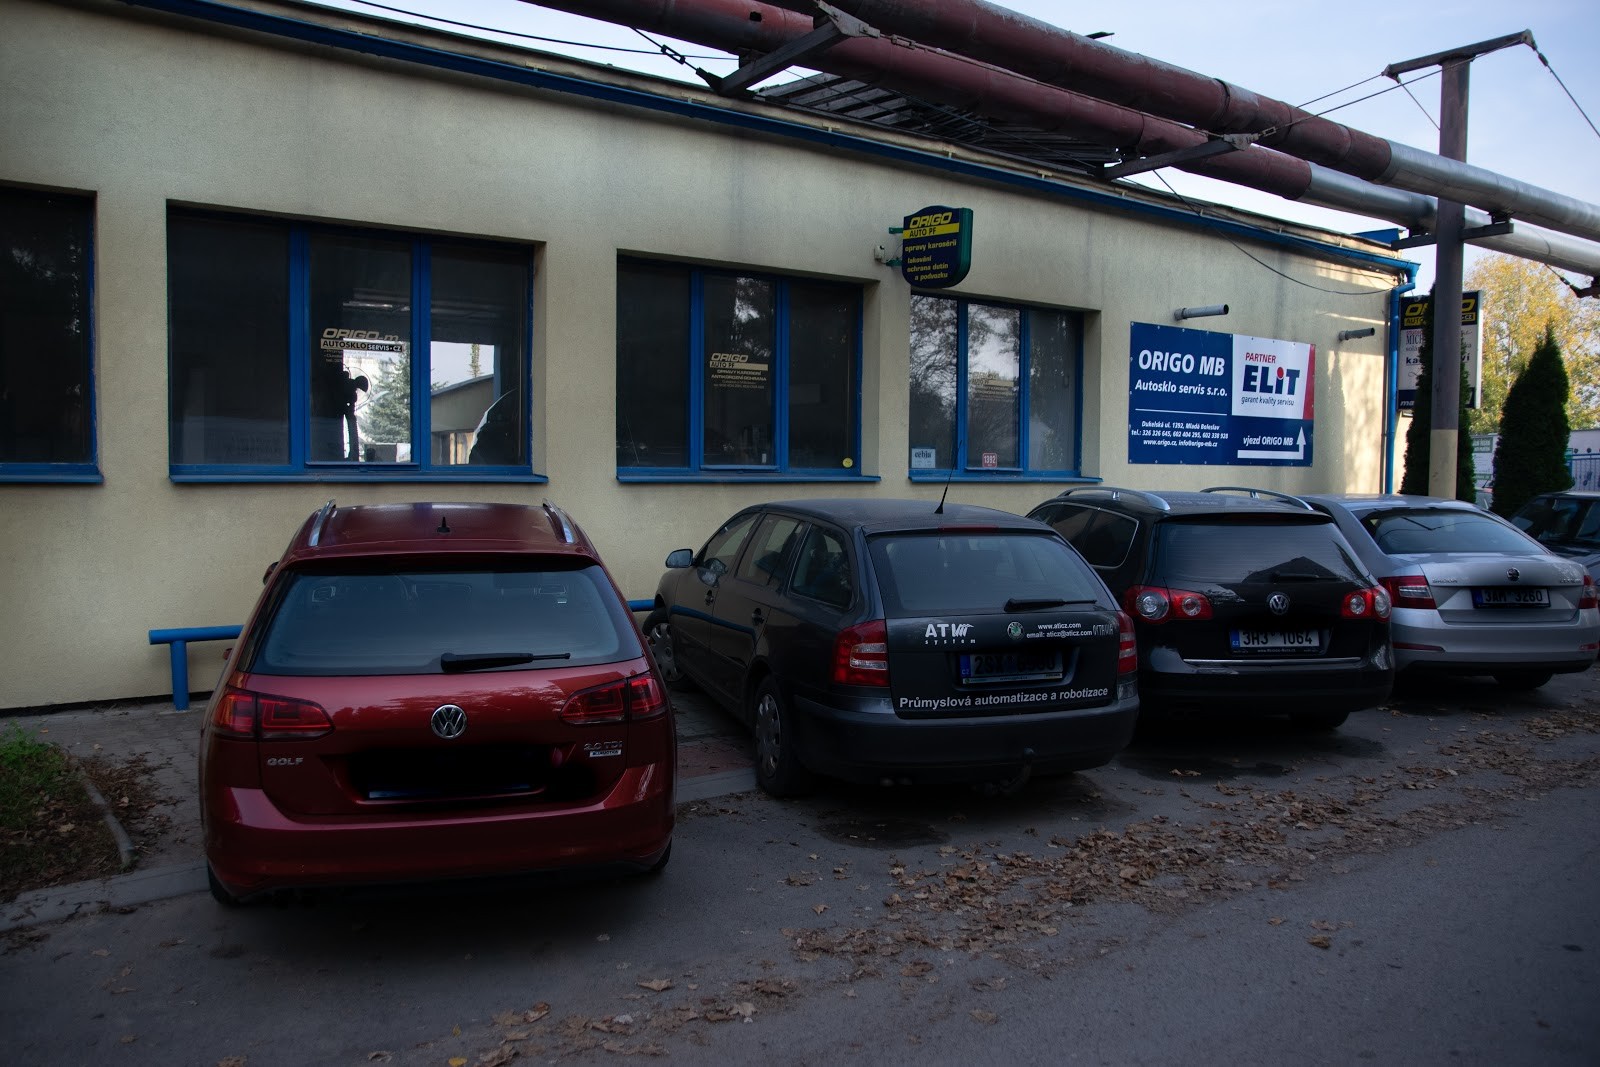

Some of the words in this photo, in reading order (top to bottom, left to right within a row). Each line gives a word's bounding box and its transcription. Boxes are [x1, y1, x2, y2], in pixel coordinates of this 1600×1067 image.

[910, 212, 952, 228] ORIGO
[910, 228, 927, 238] AUTO
[928, 227, 936, 236] PF
[904, 244, 926, 252] opravy
[920, 272, 948, 281] podvozku
[322, 340, 367, 349] AUTOSKLO
[711, 352, 749, 362] ORIGO
[1138, 349, 1195, 374] ORIGO
[1198, 356, 1226, 376] MB
[1246, 352, 1276, 364] PARTNER
[1135, 379, 1177, 393] Autosklo
[1179, 384, 1205, 395] servis
[1206, 387, 1228, 396] s.r.o.
[1241, 396, 1258, 405] garant
[1259, 396, 1276, 406] kvality
[1243, 435, 1261, 446] vjezd
[1262, 436, 1282, 446] ORIGO
[1283, 437, 1293, 446] MB
[900, 696, 972, 710] Průmyslová
[975, 692, 1048, 705] automatizace
[1059, 687, 1108, 700] robotizace
[267, 758, 304, 766] GOLF
